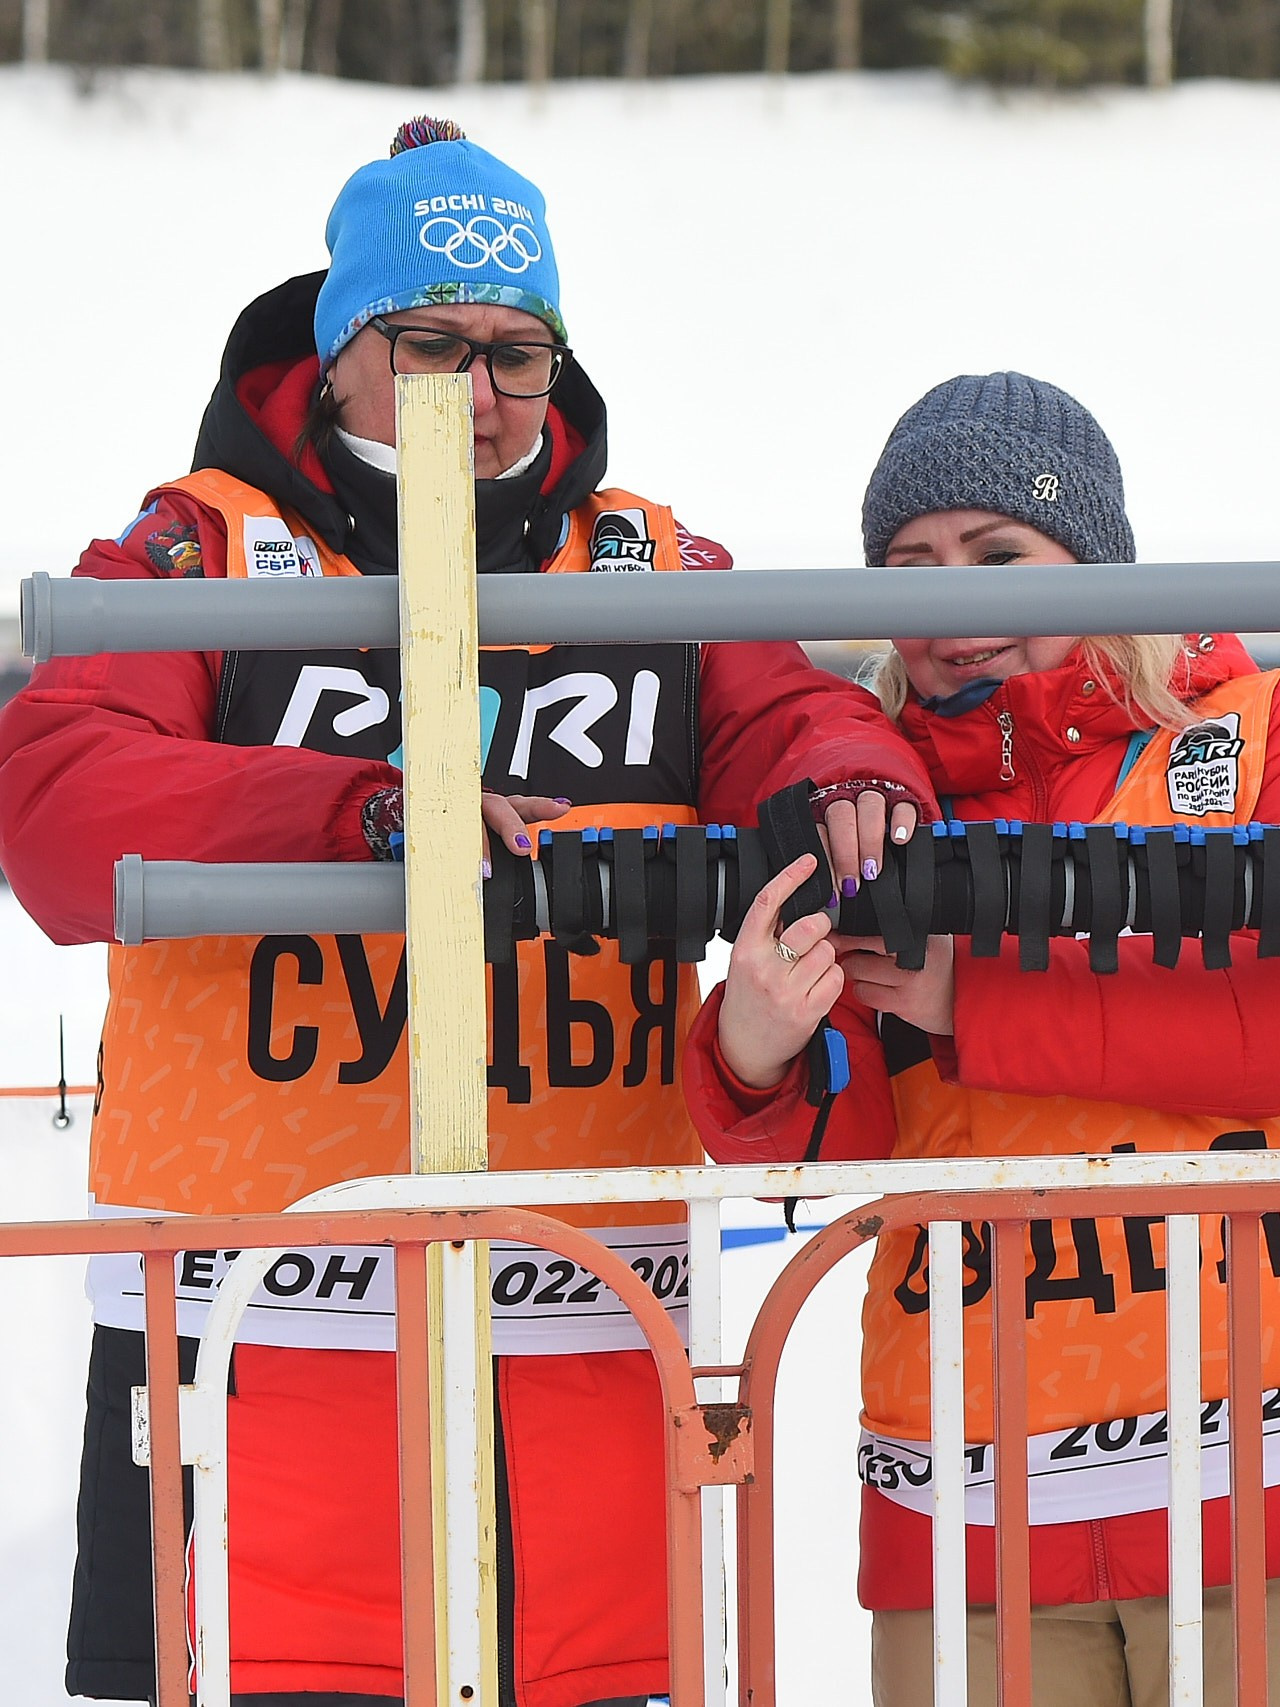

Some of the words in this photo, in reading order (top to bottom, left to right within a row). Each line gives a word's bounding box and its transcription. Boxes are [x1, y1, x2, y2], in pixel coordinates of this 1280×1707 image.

[414, 194, 486, 217] SOCHI
[491, 197, 535, 226] 2014
[254, 541, 292, 551] PARI
[256, 559, 296, 571] СБР
[592, 564, 611, 572] ARI
[273, 665, 662, 780] PRI
[1174, 770, 1197, 780] PARI
[1197, 764, 1228, 777] КУБОК
[1175, 775, 1229, 793] РОССИИ
[139, 1249, 380, 1301] ЕОН
